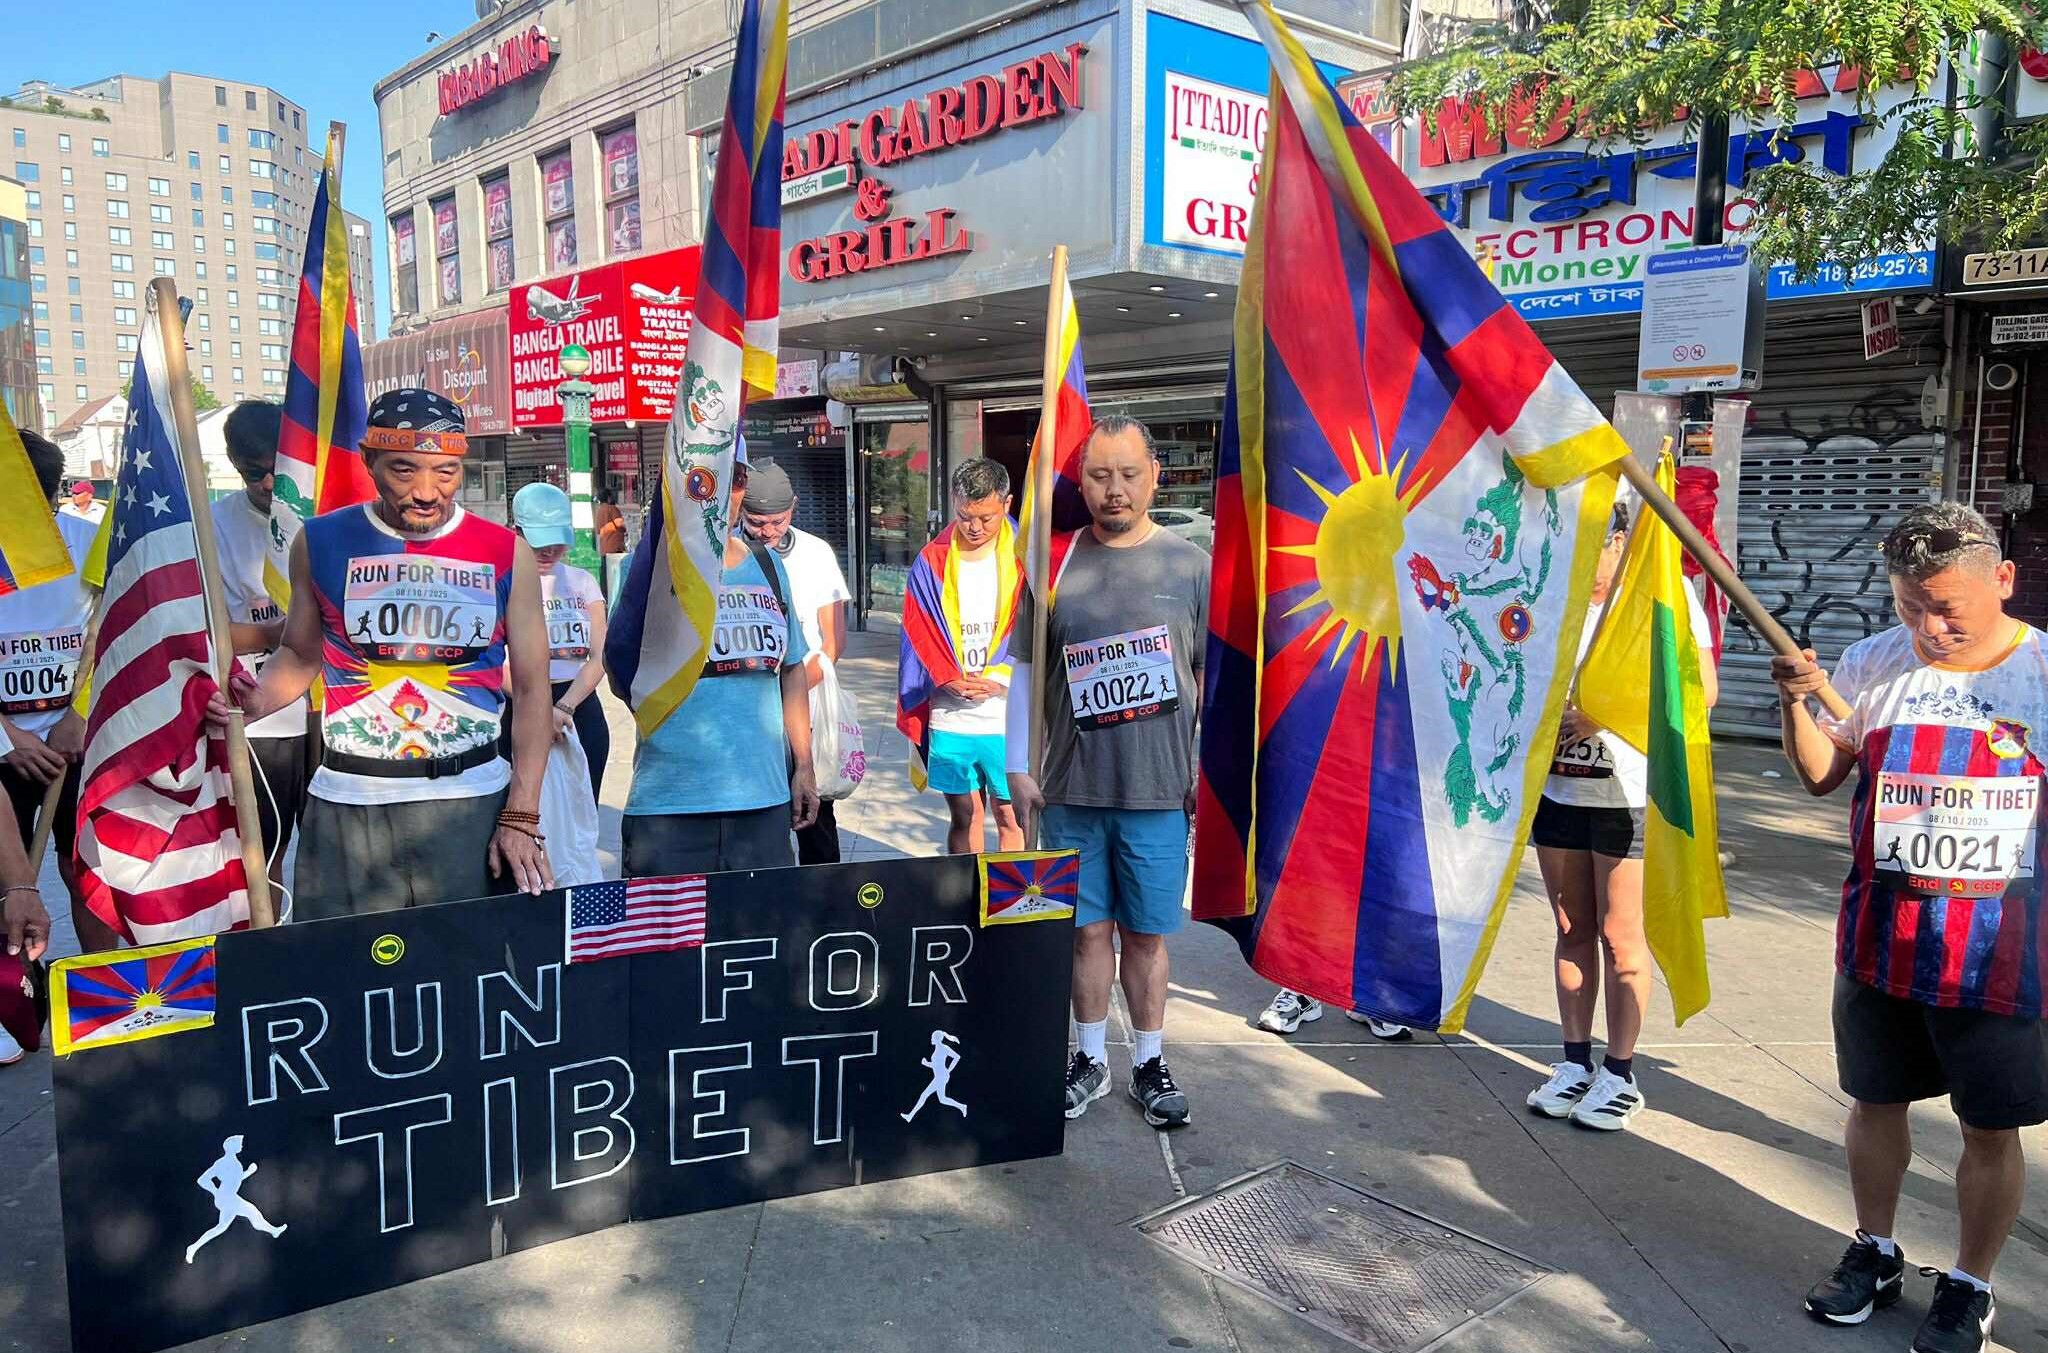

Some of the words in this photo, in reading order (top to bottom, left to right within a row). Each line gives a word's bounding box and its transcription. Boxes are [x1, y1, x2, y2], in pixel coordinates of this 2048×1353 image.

[437, 52, 497, 116] KABAB
[497, 25, 550, 87] KING
[860, 41, 1086, 168] GARDEN
[1171, 84, 1250, 140] ITTADI
[853, 176, 891, 221] &
[788, 207, 972, 284] GRILL
[1500, 254, 1641, 288] Money
[640, 307, 692, 319] BANGLA
[643, 318, 689, 330] TRAVEL
[1869, 300, 1890, 327] ATM
[1995, 317, 2028, 326] ROLLING
[513, 327, 566, 356] BANGLA
[568, 316, 623, 346] TRAVEL
[630, 342, 668, 351] BANGLA
[1866, 326, 1898, 358] INSIDE
[443, 364, 487, 390] Discount
[637, 380, 673, 388] DIGITAL
[1706, 380, 1724, 388] NYC
[515, 382, 554, 411] Digital
[474, 404, 493, 416] Wines
[351, 565, 388, 584] RUN
[397, 564, 434, 584] FOR
[440, 566, 493, 590] TIBET
[429, 589, 448, 598] 2025
[718, 593, 748, 609] FOR
[251, 604, 278, 622] RUN
[378, 603, 462, 641] 0006
[714, 625, 776, 655] 0005
[961, 623, 980, 635] FOR
[11, 638, 42, 655] FOR
[46, 633, 82, 651] TIBET
[378, 645, 407, 656] End
[434, 646, 464, 658] CCP
[1067, 648, 1094, 669] RUN
[1098, 643, 1126, 662] FOR
[1129, 633, 1168, 656] TIBET
[716, 660, 740, 672] End
[5, 664, 67, 696] 0004
[1093, 672, 1155, 710] 0022
[1097, 713, 1119, 724] End
[1138, 704, 1160, 716] CCP
[1568, 765, 1591, 774] CCP
[1881, 783, 1923, 806] RUN
[1930, 786, 1973, 809] FOR
[1982, 788, 2036, 810] TIBET
[1967, 816, 1989, 826] 2025
[1910, 833, 2002, 873] 0021
[1909, 876, 1941, 891] End
[1972, 879, 2004, 892] CCP
[242, 962, 561, 1106] RUN
[701, 924, 975, 1023] FOR
[334, 1031, 878, 1234] TIBET
